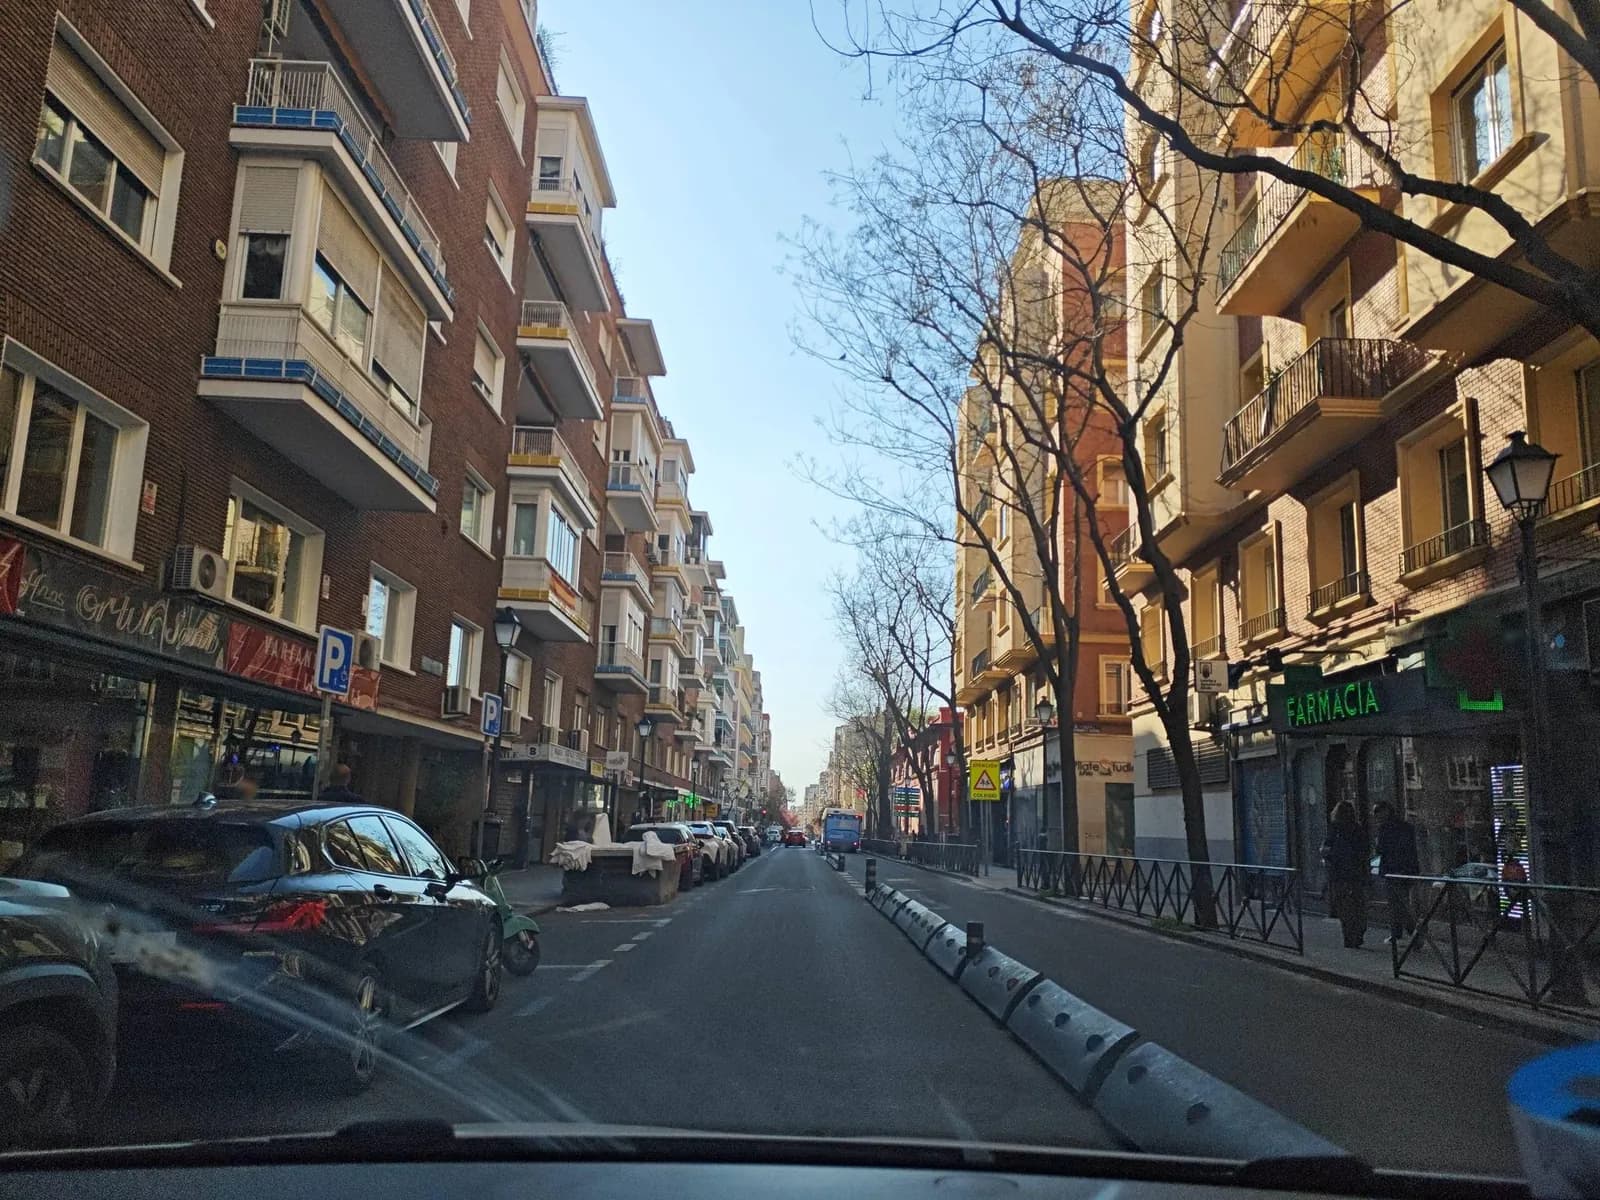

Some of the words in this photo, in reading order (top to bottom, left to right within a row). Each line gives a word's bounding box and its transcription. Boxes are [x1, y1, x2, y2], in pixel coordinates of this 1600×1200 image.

[323, 635, 345, 684] P
[485, 698, 498, 730] P
[1287, 680, 1379, 727] FARMACIA
